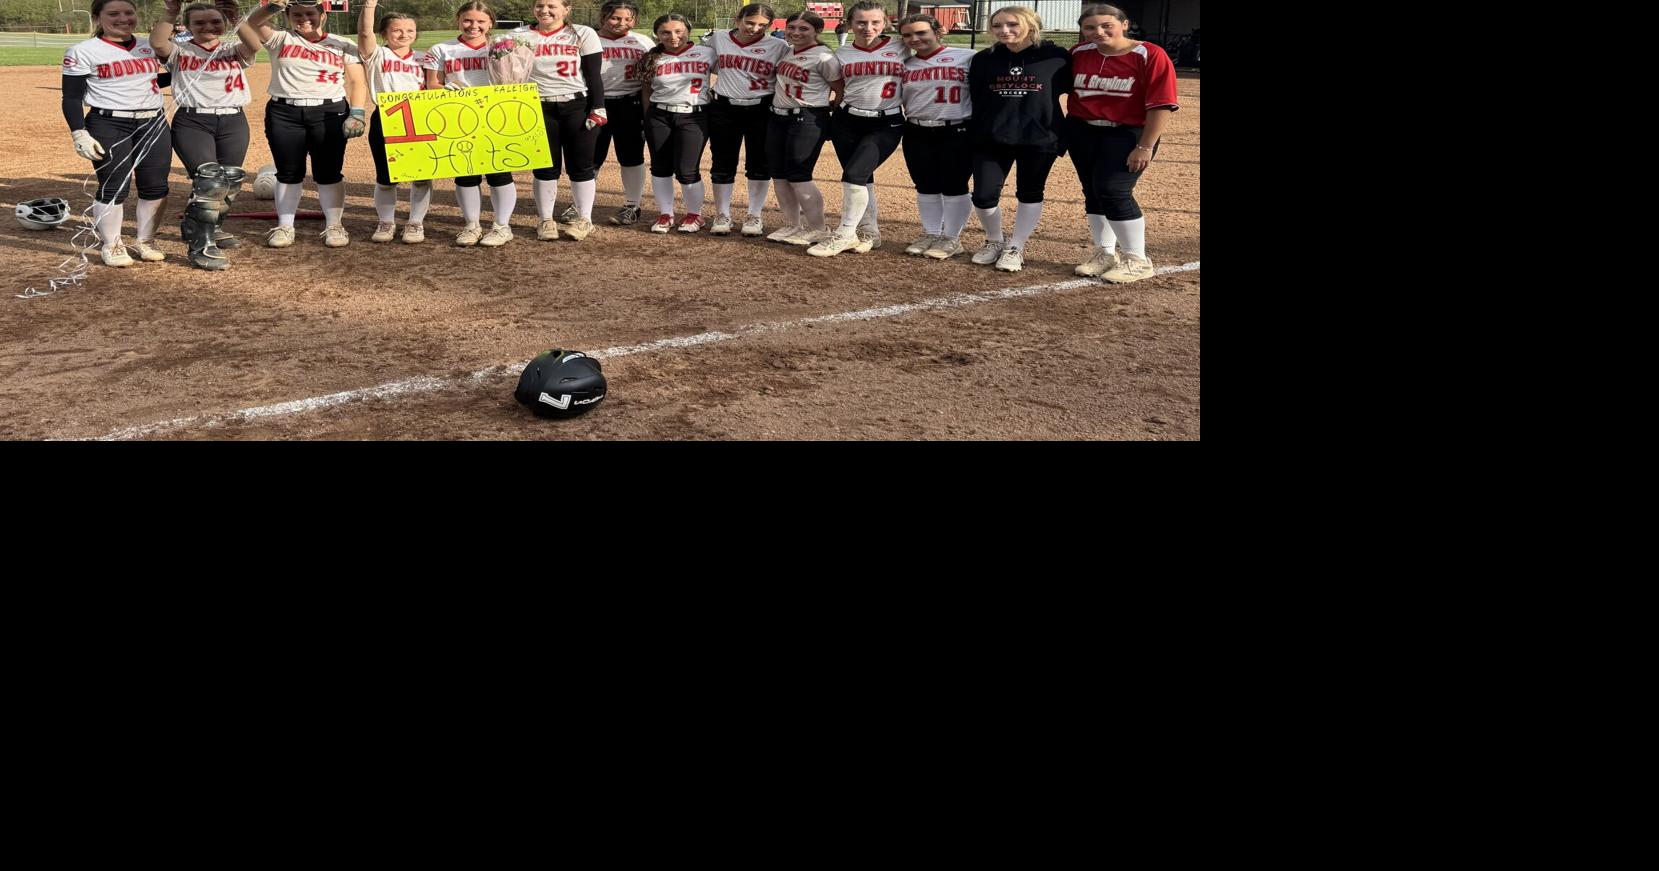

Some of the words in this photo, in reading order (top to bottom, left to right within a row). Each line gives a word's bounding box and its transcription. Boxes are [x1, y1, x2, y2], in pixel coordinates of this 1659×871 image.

[315, 69, 339, 84] 14
[382, 59, 425, 78] MOUNT
[556, 60, 578, 77] 21
[842, 61, 904, 77] OUNTIE
[225, 74, 245, 93] 24
[689, 78, 704, 95] 2
[881, 81, 897, 99] 6
[380, 89, 478, 104] CONGRATULATIONS
[934, 86, 962, 104] 10
[539, 392, 571, 410] 7
